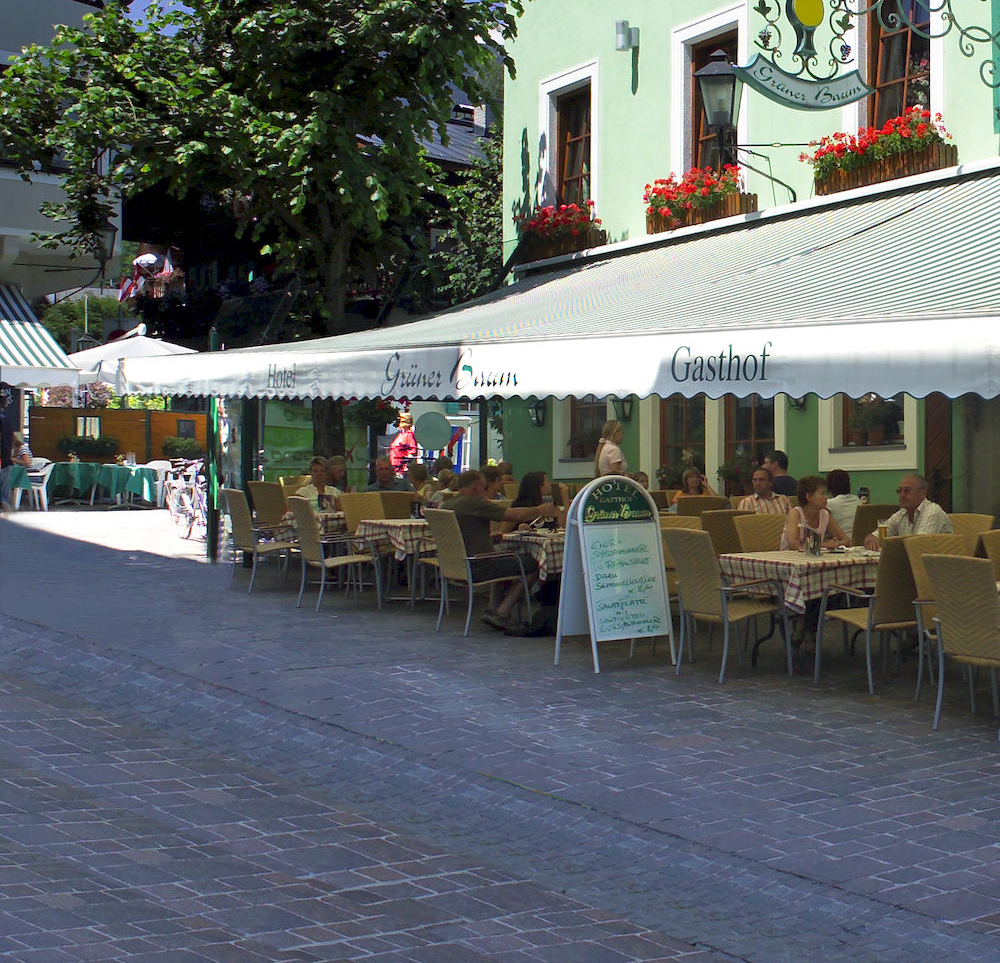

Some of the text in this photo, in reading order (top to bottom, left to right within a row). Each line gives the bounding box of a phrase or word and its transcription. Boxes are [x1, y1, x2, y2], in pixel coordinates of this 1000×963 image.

[815, 84, 862, 105] Baum
[268, 341, 773, 397] Hotel Grüner Baum Gasthof
[592, 482, 640, 501] HOTEL
